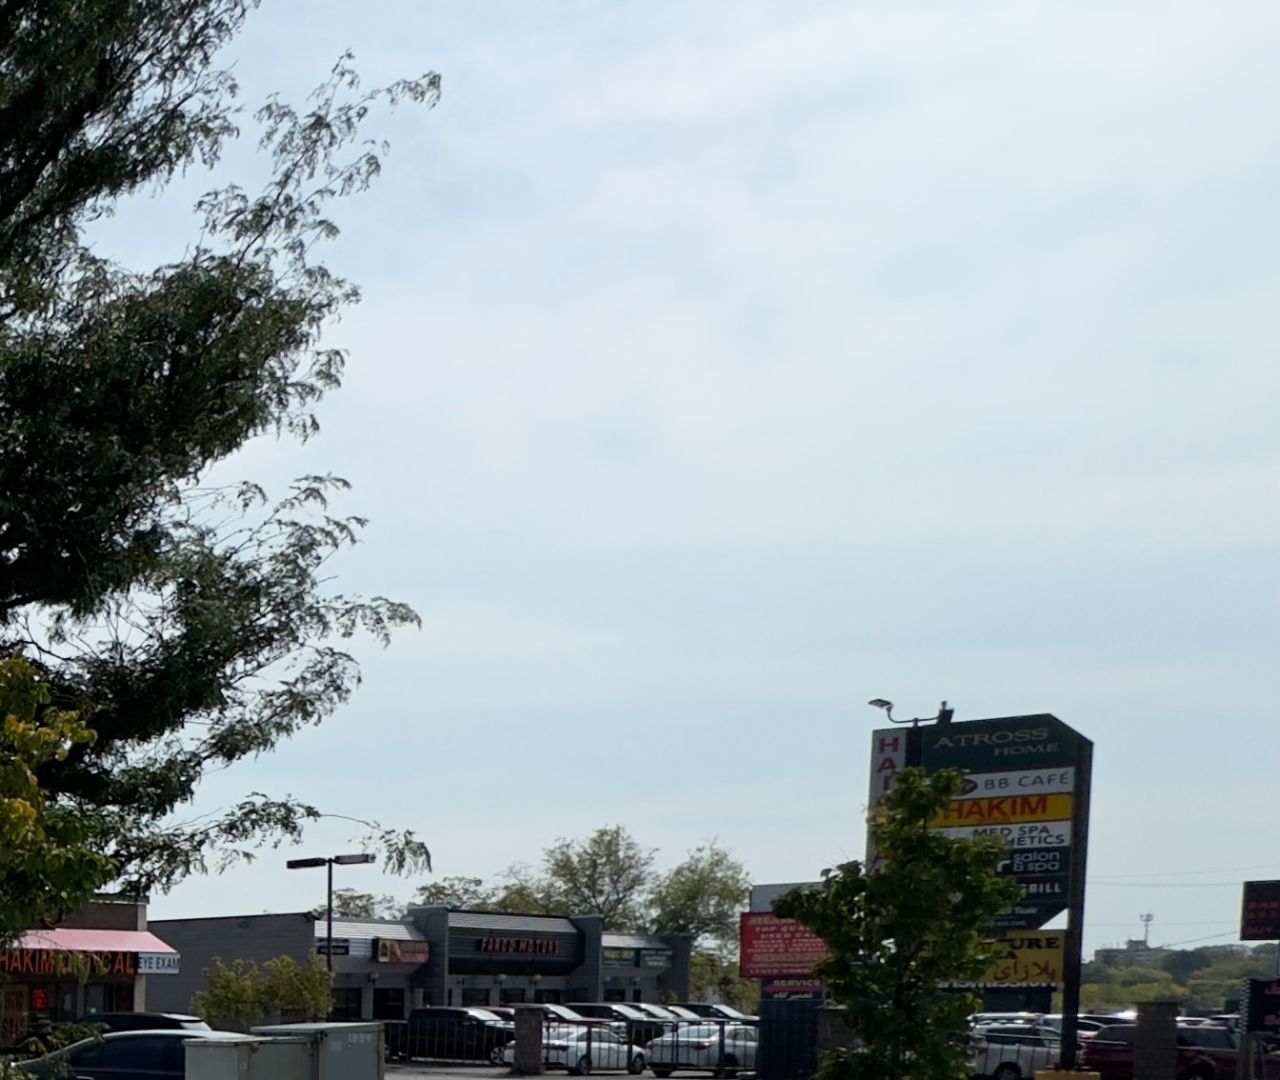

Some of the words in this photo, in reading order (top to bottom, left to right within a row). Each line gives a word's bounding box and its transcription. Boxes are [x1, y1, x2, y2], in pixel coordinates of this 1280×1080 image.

[933, 727, 1049, 749] ATROSS
[993, 743, 1059, 757] HOME
[984, 778, 1010, 790] BB
[1018, 771, 1070, 788] CAFÉ
[943, 795, 1048, 820] HAKIM
[1018, 825, 1050, 836] SPA
[1012, 851, 1061, 862] salon
[1026, 861, 1060, 872] spa
[138, 956, 154, 969] EYE
